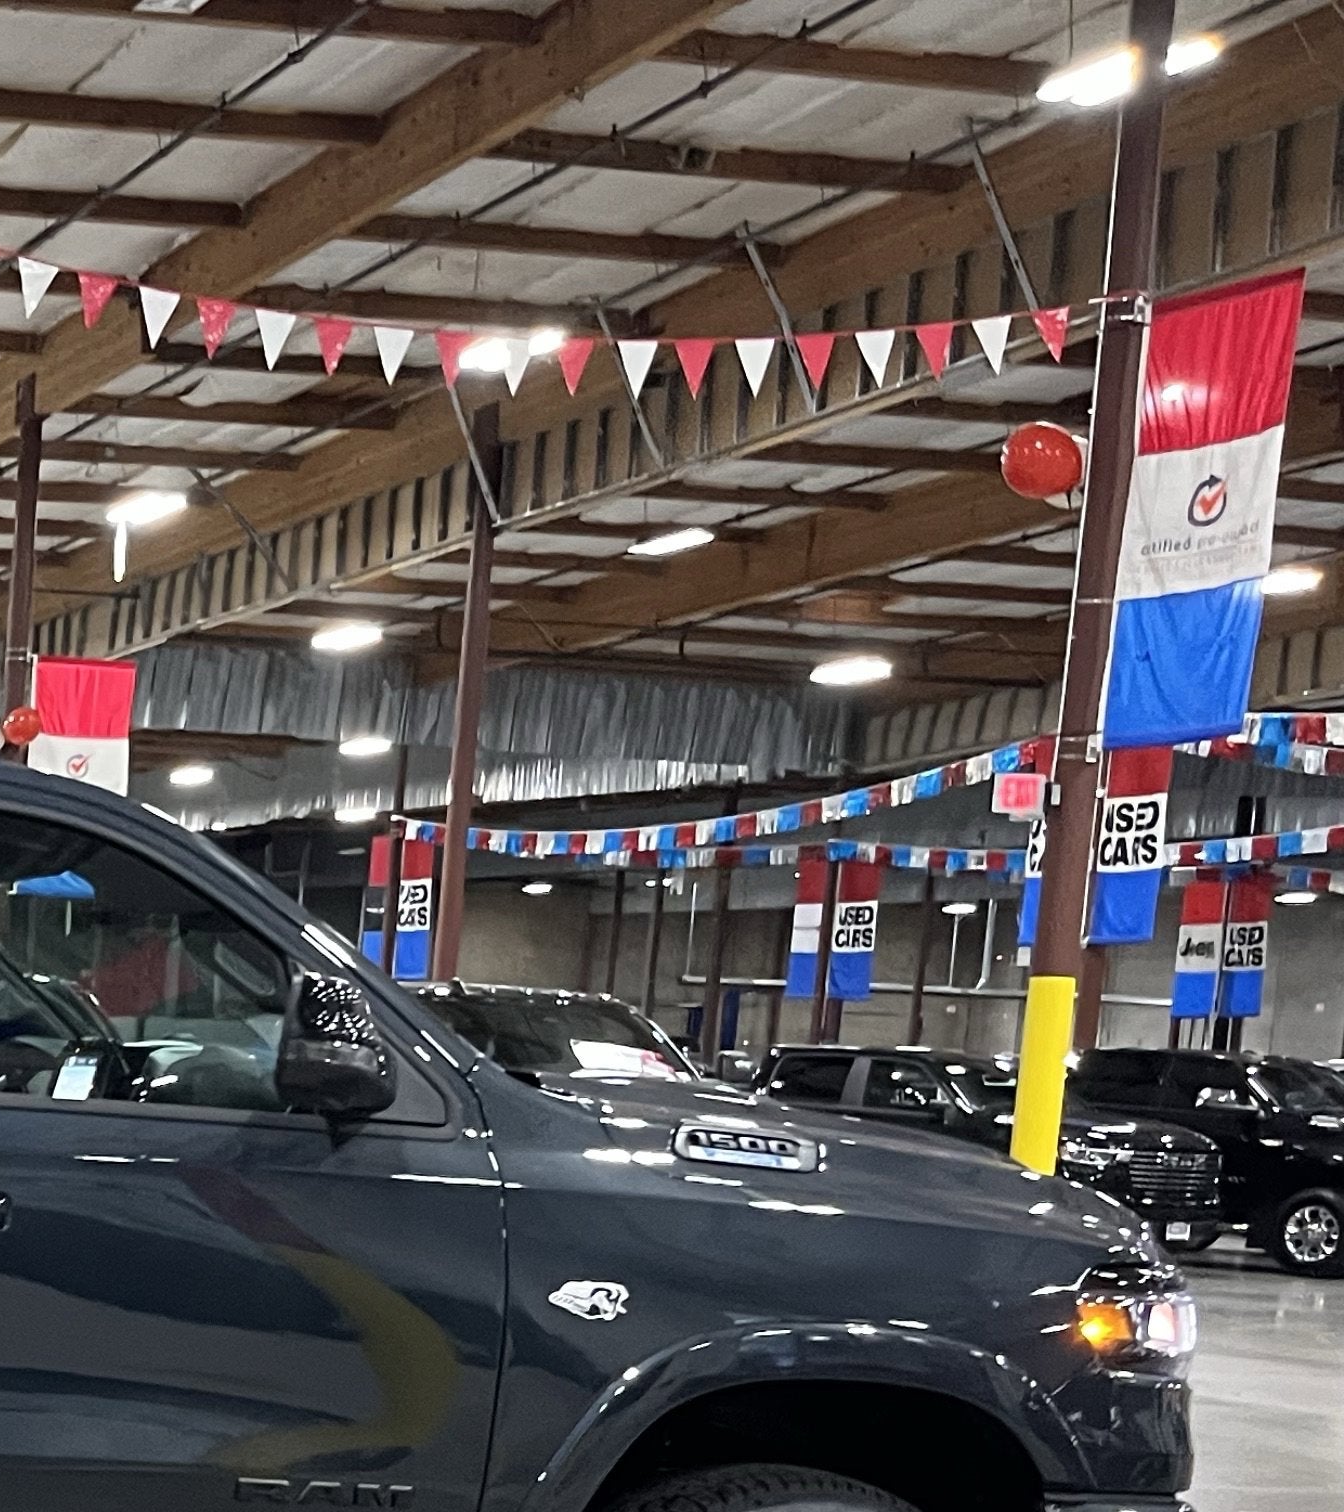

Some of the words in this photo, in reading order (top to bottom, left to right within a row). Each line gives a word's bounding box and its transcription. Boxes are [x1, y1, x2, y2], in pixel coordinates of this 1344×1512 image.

[399, 884, 428, 905] UED
[397, 906, 428, 927] CAS
[838, 906, 874, 926] USED
[689, 1131, 799, 1157] 1500
